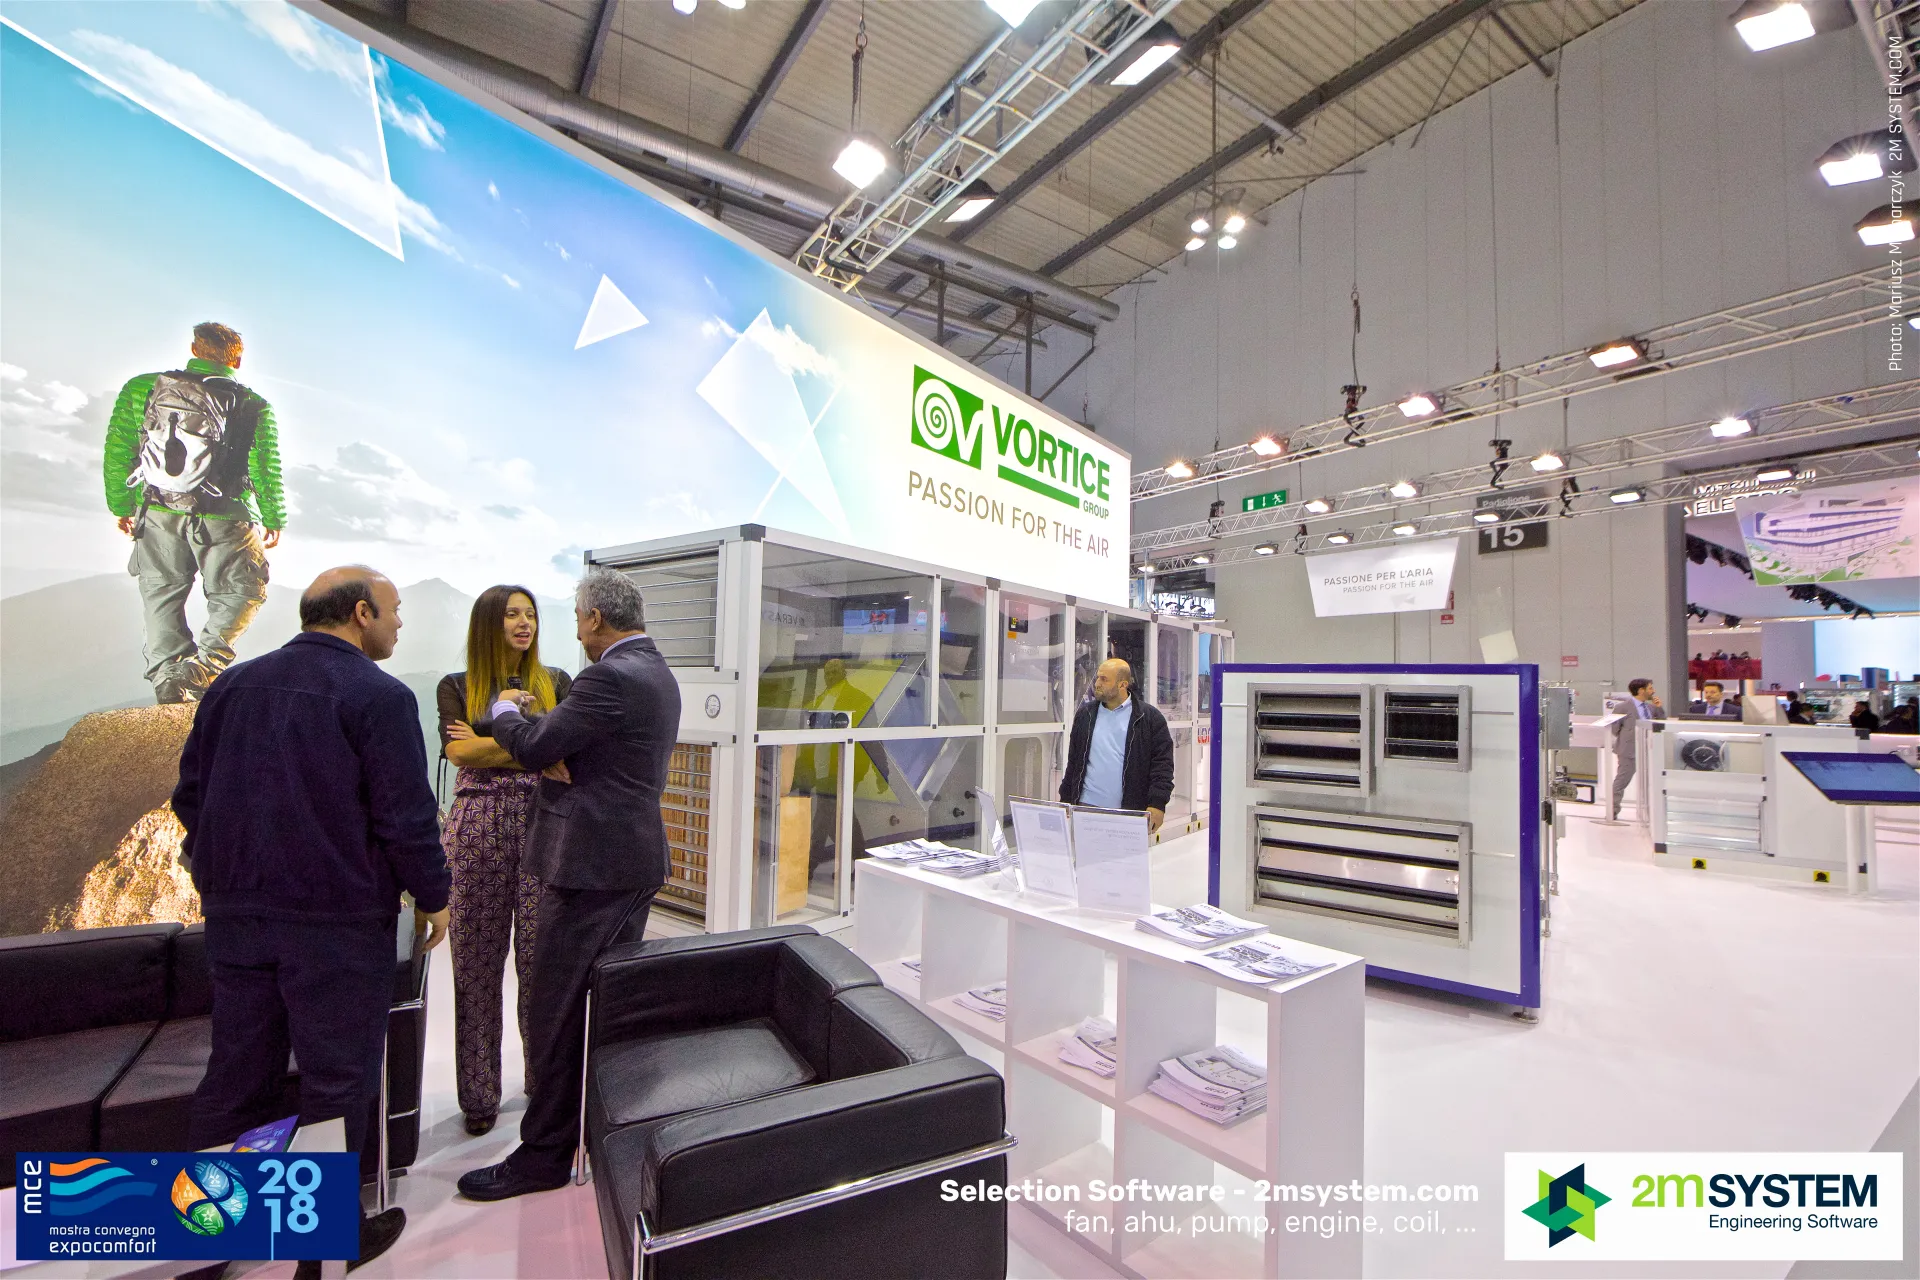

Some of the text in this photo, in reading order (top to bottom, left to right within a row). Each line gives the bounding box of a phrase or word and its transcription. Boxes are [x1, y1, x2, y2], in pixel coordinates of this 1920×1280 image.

[992, 404, 1110, 502] VORTICE
[908, 470, 1109, 558] PASSION FOR THE AIR
[1083, 499, 1109, 520] GROUP
[1484, 524, 1524, 549] 15
[1324, 567, 1433, 586] PASSIONE PER L'ARIA
[1343, 579, 1434, 593] PASSION FOR THE AIR
